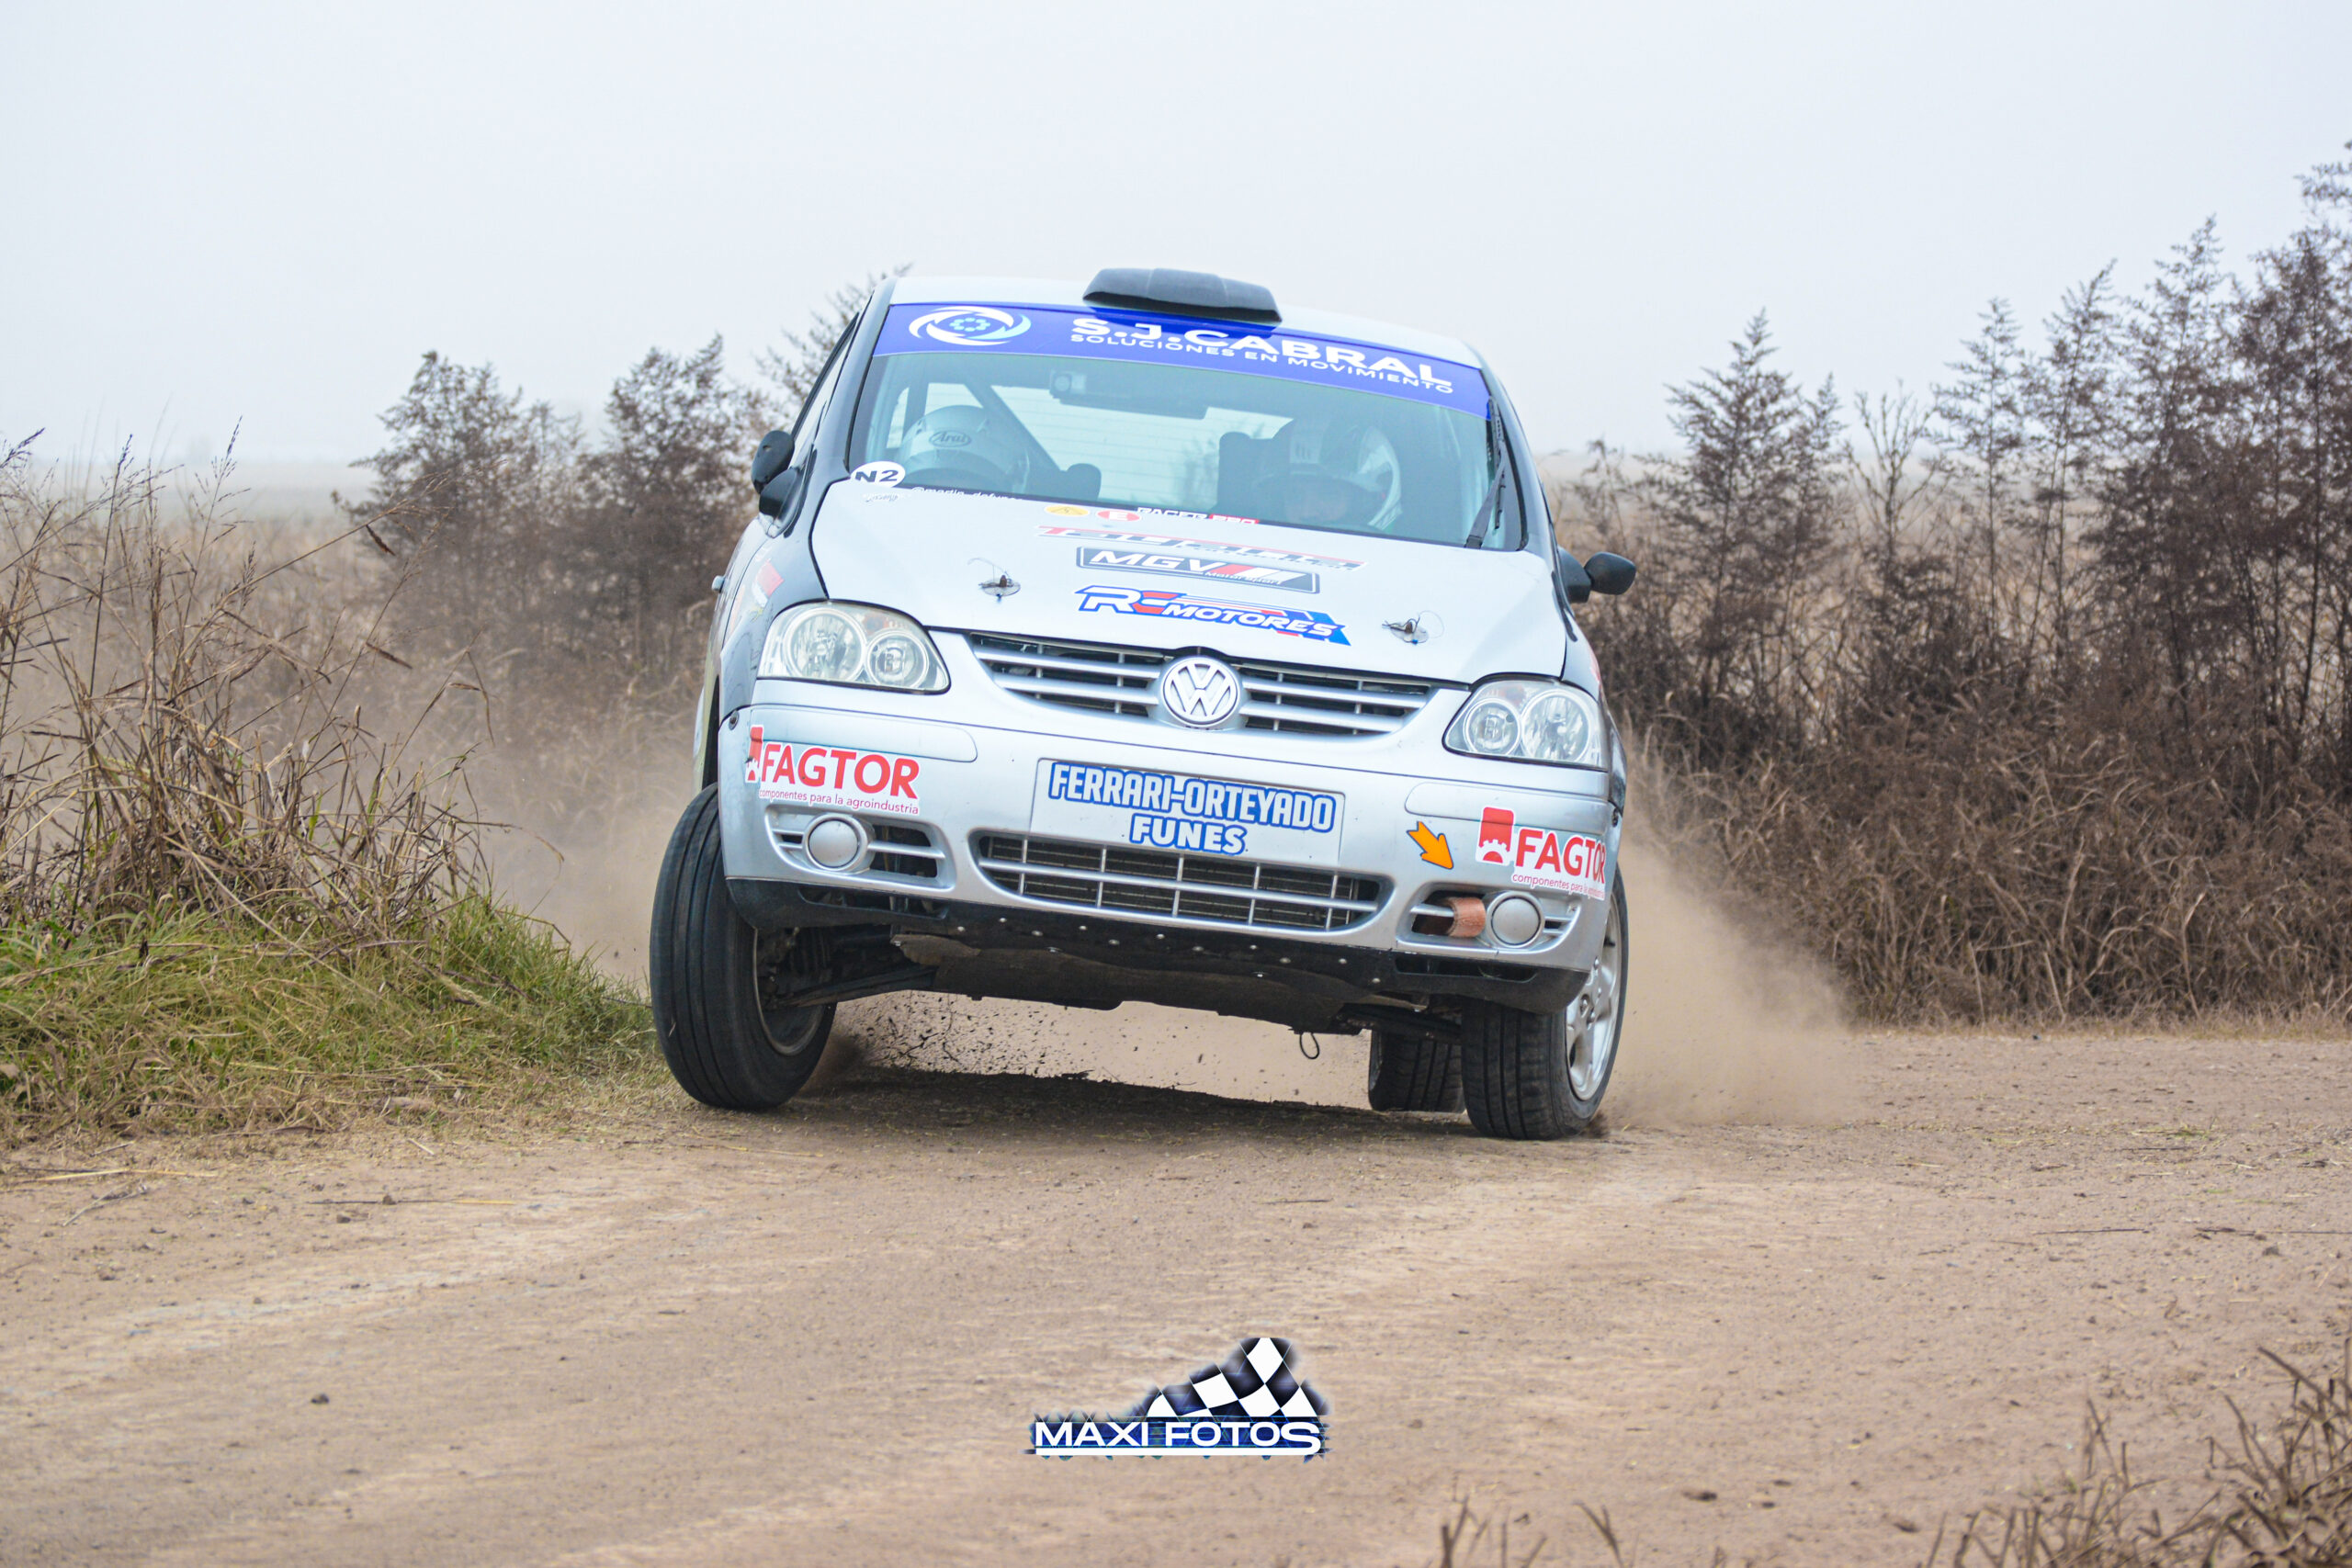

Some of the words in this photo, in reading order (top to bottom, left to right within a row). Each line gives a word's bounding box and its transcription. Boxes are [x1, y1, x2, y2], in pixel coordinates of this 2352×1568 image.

[1070, 333, 1236, 357] SOLUCIONES
[1244, 351, 1278, 363] EN
[1287, 356, 1454, 394] MOVIMIENTO
[855, 469, 899, 483] N2
[1089, 550, 1227, 572] MGV
[1160, 603, 1340, 637] MOTORES
[761, 743, 920, 799] FAGTOR
[759, 788, 808, 802] componentes
[809, 794, 832, 805] para
[834, 794, 843, 805] la
[846, 798, 919, 815] agroindustria
[1131, 815, 1246, 854] FUNES
[1515, 828, 1606, 885] FAGTOR
[1512, 874, 1569, 889] componentes
